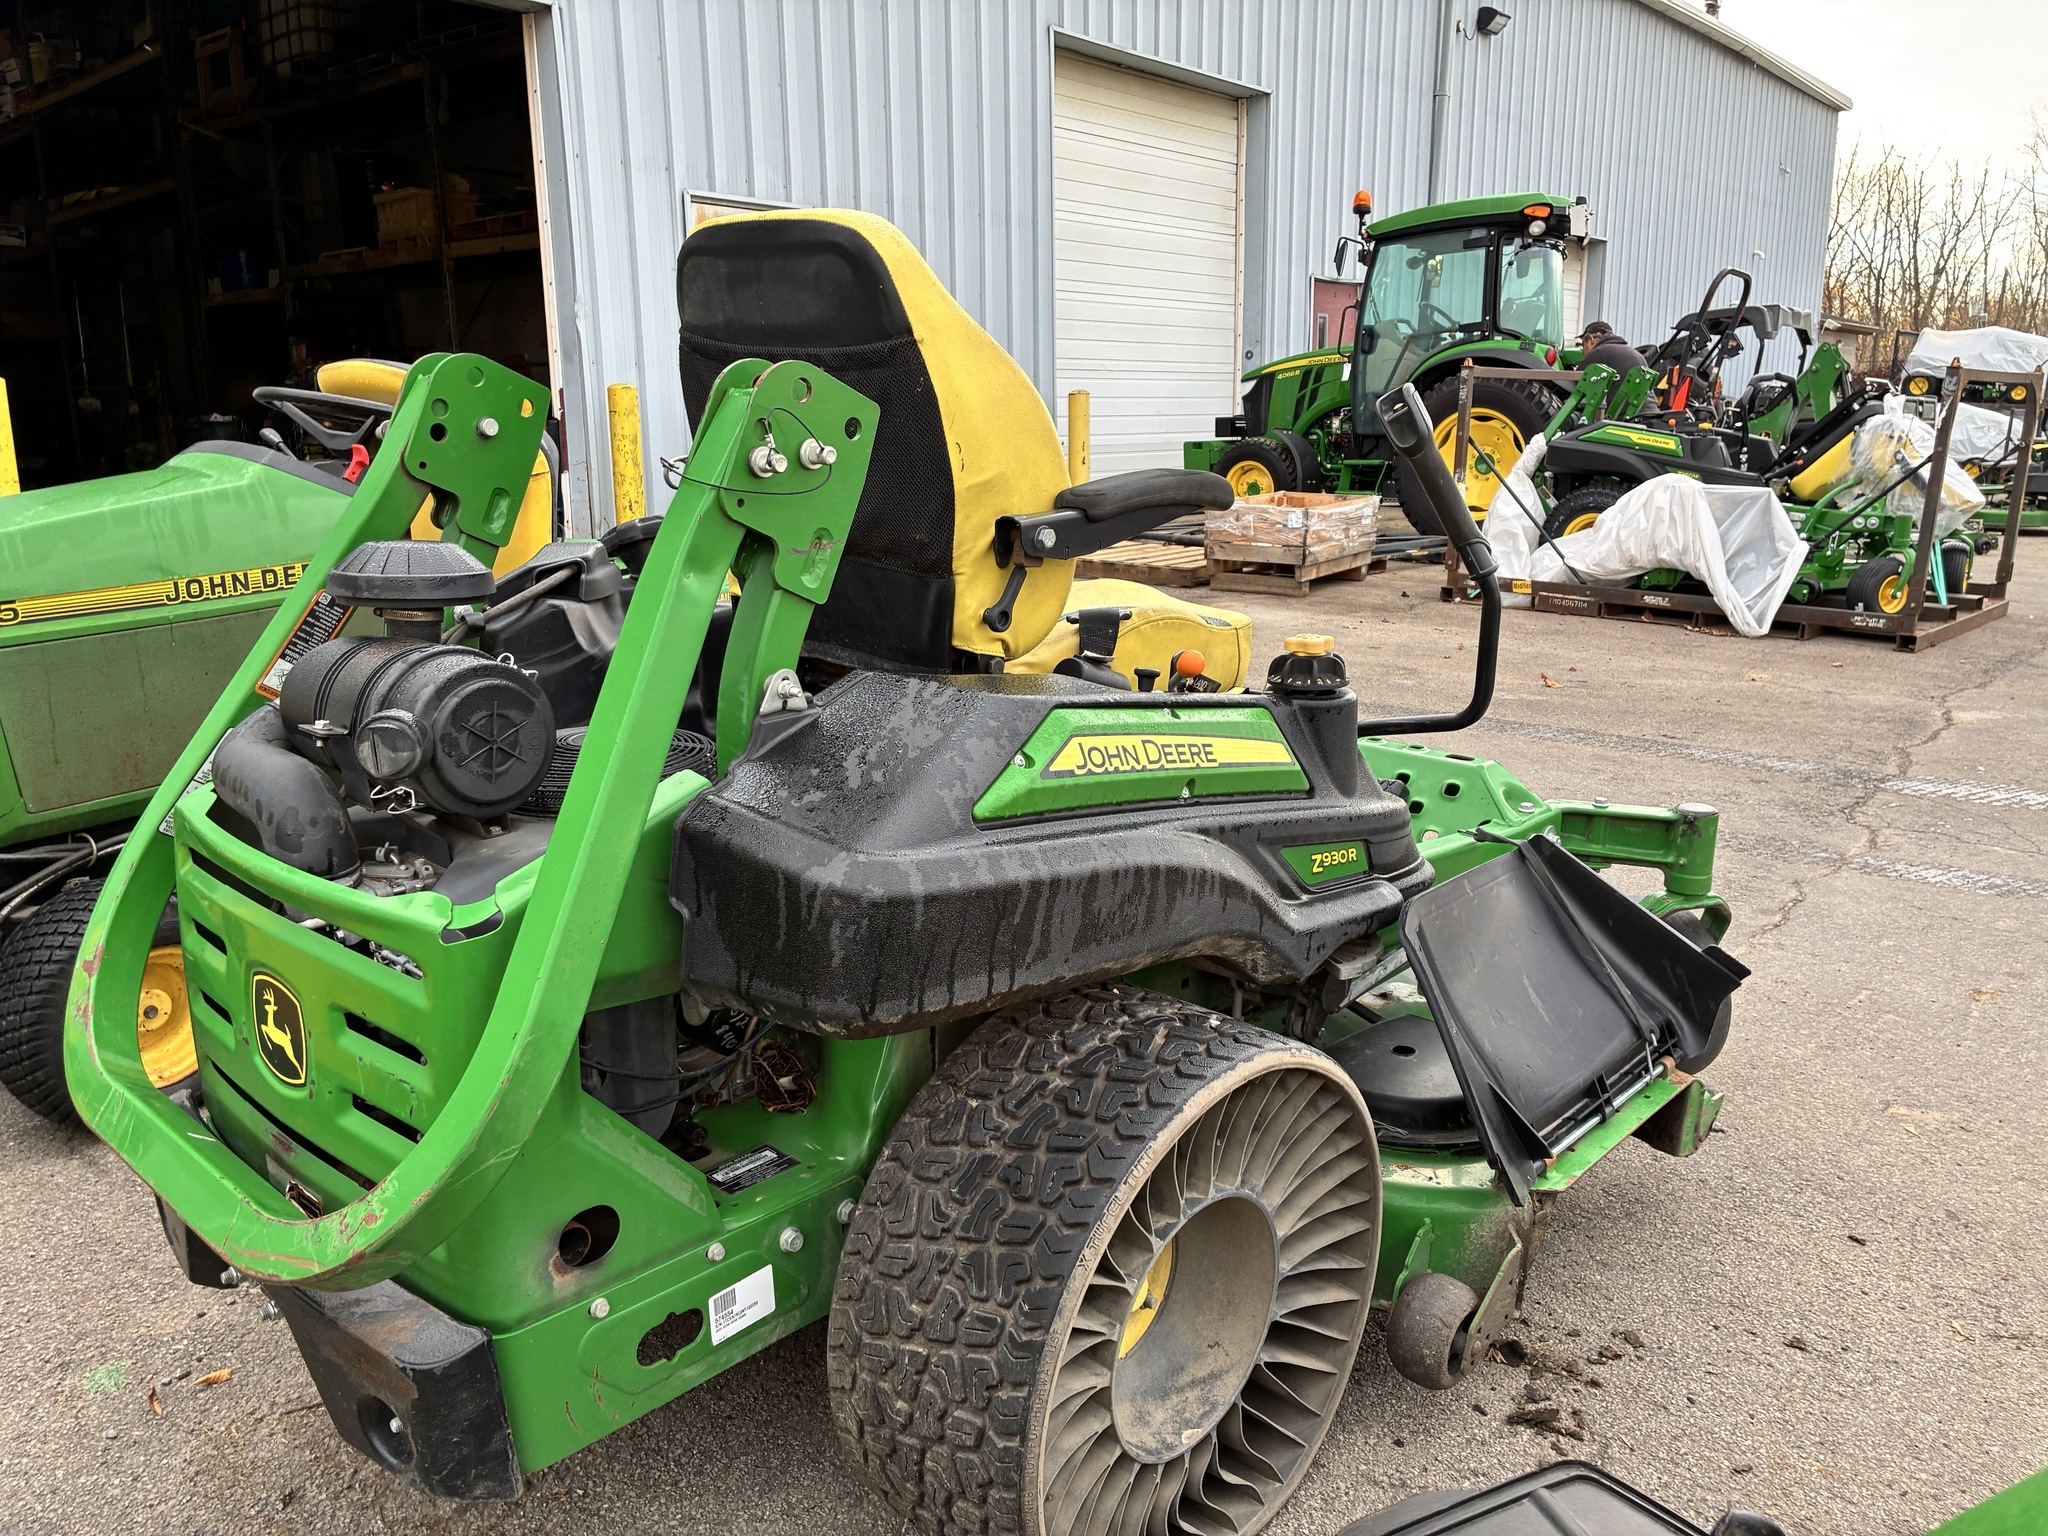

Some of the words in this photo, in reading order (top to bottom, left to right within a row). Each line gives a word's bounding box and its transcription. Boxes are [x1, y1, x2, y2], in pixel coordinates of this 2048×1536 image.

[1277, 369, 1300, 380] 4066R
[1652, 438, 1671, 446] DEERE
[165, 572, 251, 602] JOHN
[1075, 742, 1141, 770] JOHN
[1141, 739, 1218, 765] DEERE
[1311, 847, 1357, 874] Z930R
[1085, 1194, 1128, 1251] TWEEL
[1048, 1327, 1062, 1353] USE
[1032, 1358, 1053, 1418] HIGHWAY
[1026, 1422, 1040, 1449] FOR
[1024, 1454, 1036, 1479] NOT
[1023, 1490, 1035, 1514] NHS
